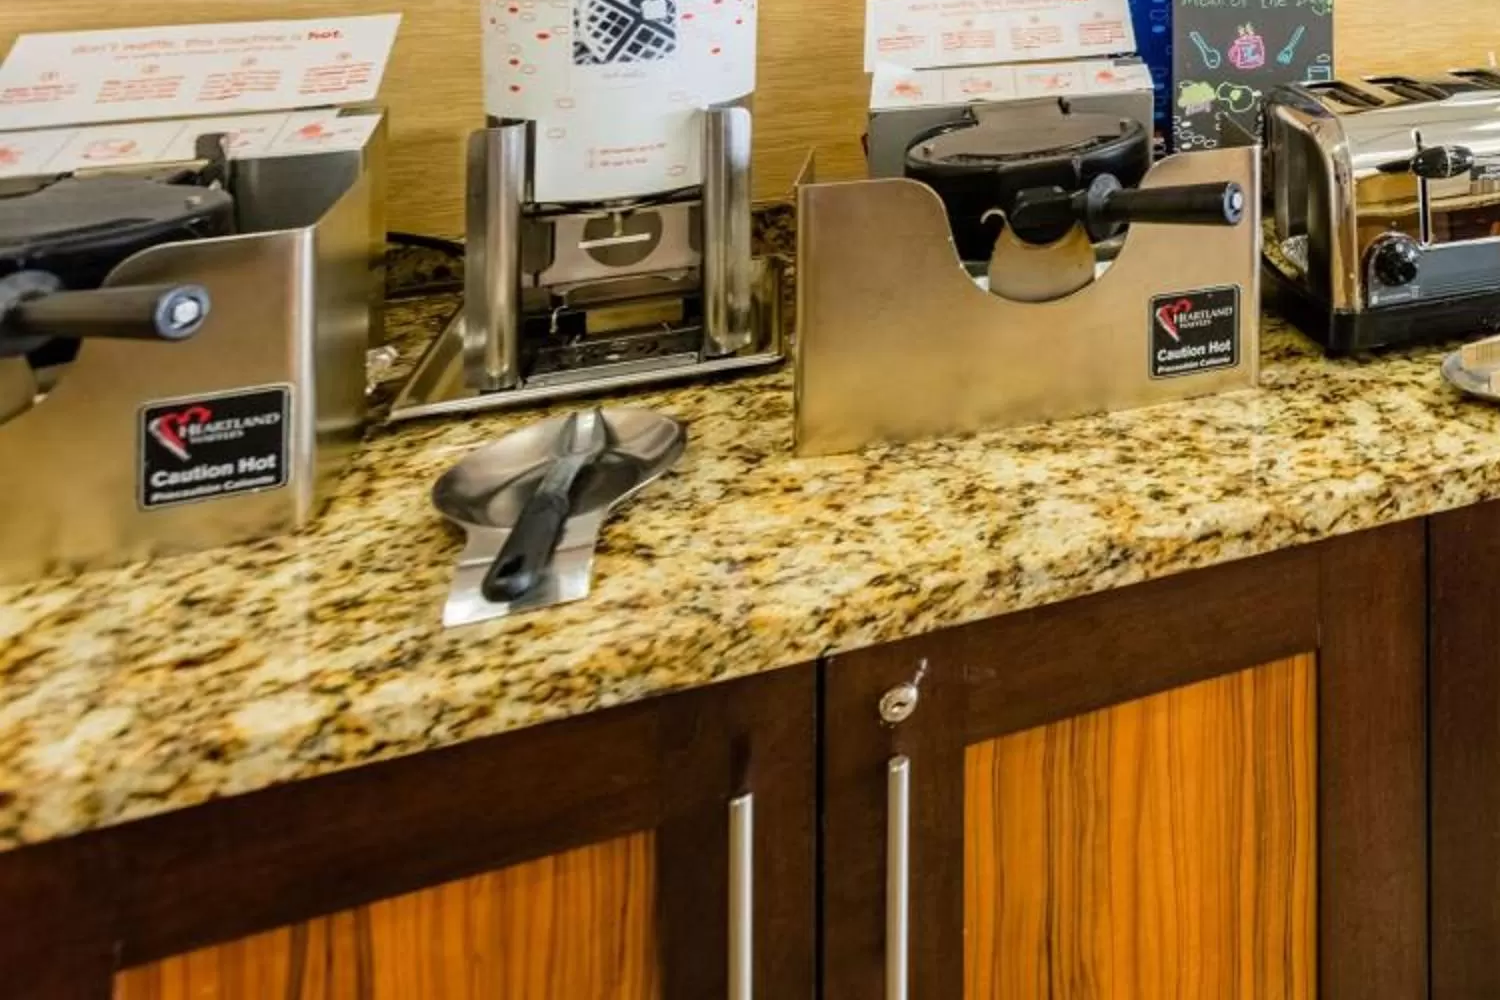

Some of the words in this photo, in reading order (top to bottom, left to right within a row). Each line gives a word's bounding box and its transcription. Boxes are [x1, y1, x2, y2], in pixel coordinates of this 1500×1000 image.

[1174, 307, 1233, 325] HEARTLAND
[1157, 345, 1205, 361] Caution
[1208, 339, 1231, 353] Hot
[178, 411, 281, 438] HEARTLAND
[151, 462, 234, 487] Caution
[238, 454, 277, 473] Hot
